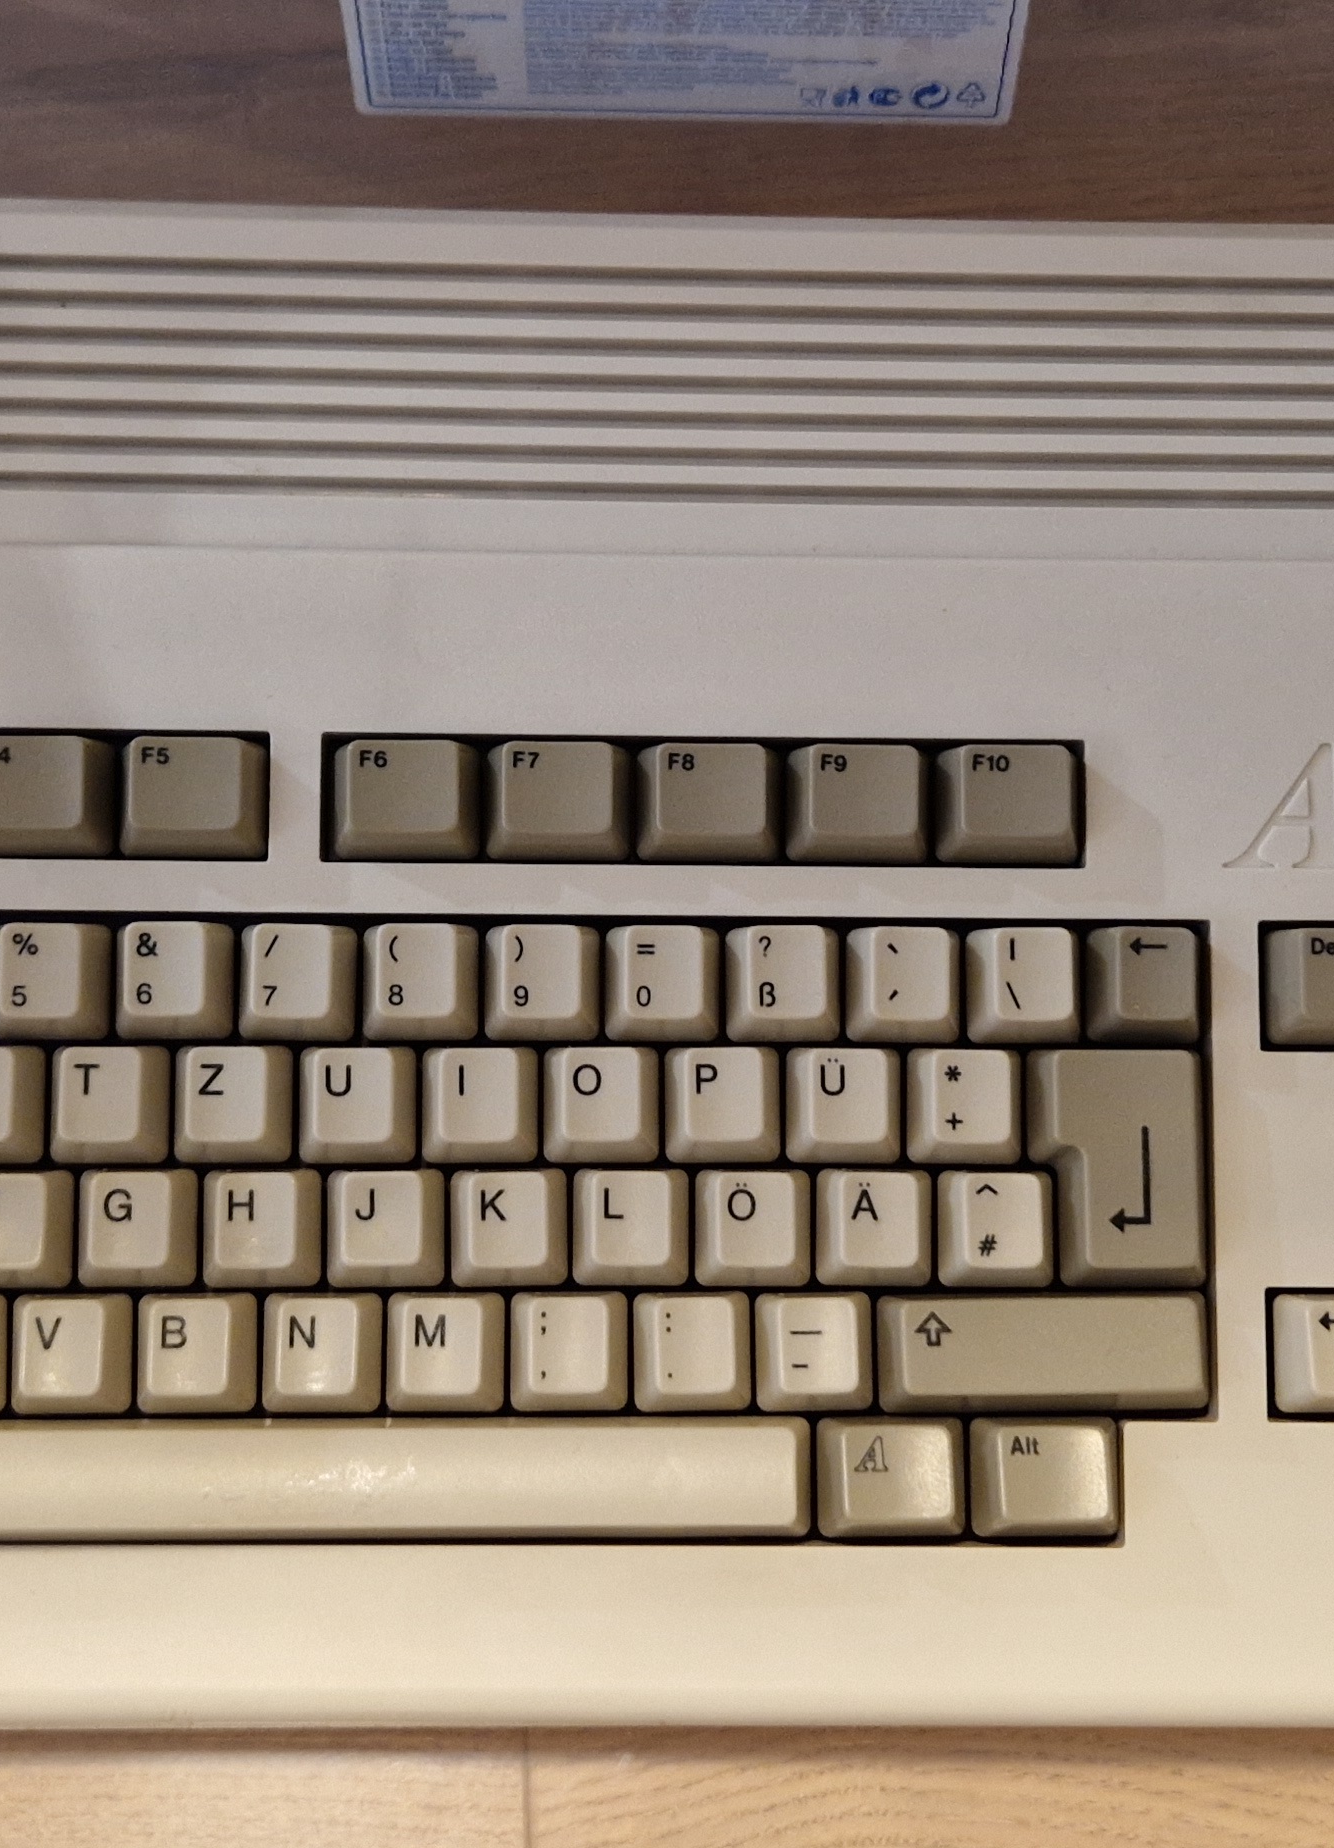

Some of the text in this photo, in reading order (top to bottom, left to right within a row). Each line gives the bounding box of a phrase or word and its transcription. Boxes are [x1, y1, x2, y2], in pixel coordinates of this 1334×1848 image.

[141, 747, 169, 765] F5
[360, 750, 387, 768] F6
[513, 751, 539, 768] F7
[668, 753, 694, 771] F8
[821, 754, 847, 772] F9
[972, 754, 1010, 772] F10
[12, 933, 38, 955] %
[136, 933, 157, 957] &
[265, 935, 278, 957] /
[389, 936, 398, 962] (
[515, 936, 523, 962] )
[637, 944, 655, 955] =
[759, 936, 771, 956] ?
[12, 985, 27, 1007] 5
[136, 983, 152, 1005] 6
[263, 985, 277, 1006] 7
[388, 984, 403, 1006] 8
[514, 985, 528, 1007] 9
[636, 986, 651, 1007] 0
[759, 982, 776, 1007] ß
[1006, 982, 1020, 1009] \
[74, 1064, 99, 1095] T
[198, 1064, 223, 1095] Z
[325, 1065, 351, 1097] U
[459, 1065, 464, 1096] I
[573, 1064, 601, 1096] O
[696, 1064, 717, 1094] P
[820, 1059, 845, 1096] Ü
[946, 1113, 963, 1130] +
[727, 1183, 756, 1221] Ö
[851, 1183, 878, 1221] Ä
[976, 1184, 997, 1195] ^
[104, 1189, 132, 1222] G
[228, 1190, 254, 1221] H
[355, 1189, 375, 1221] J
[481, 1190, 505, 1221] K
[604, 1188, 623, 1219] L
[979, 1235, 997, 1256] #
[35, 1317, 61, 1350] V
[161, 1316, 186, 1349] B
[289, 1316, 315, 1348] N
[415, 1315, 445, 1347] M
[1011, 1436, 1039, 1455] Alt
